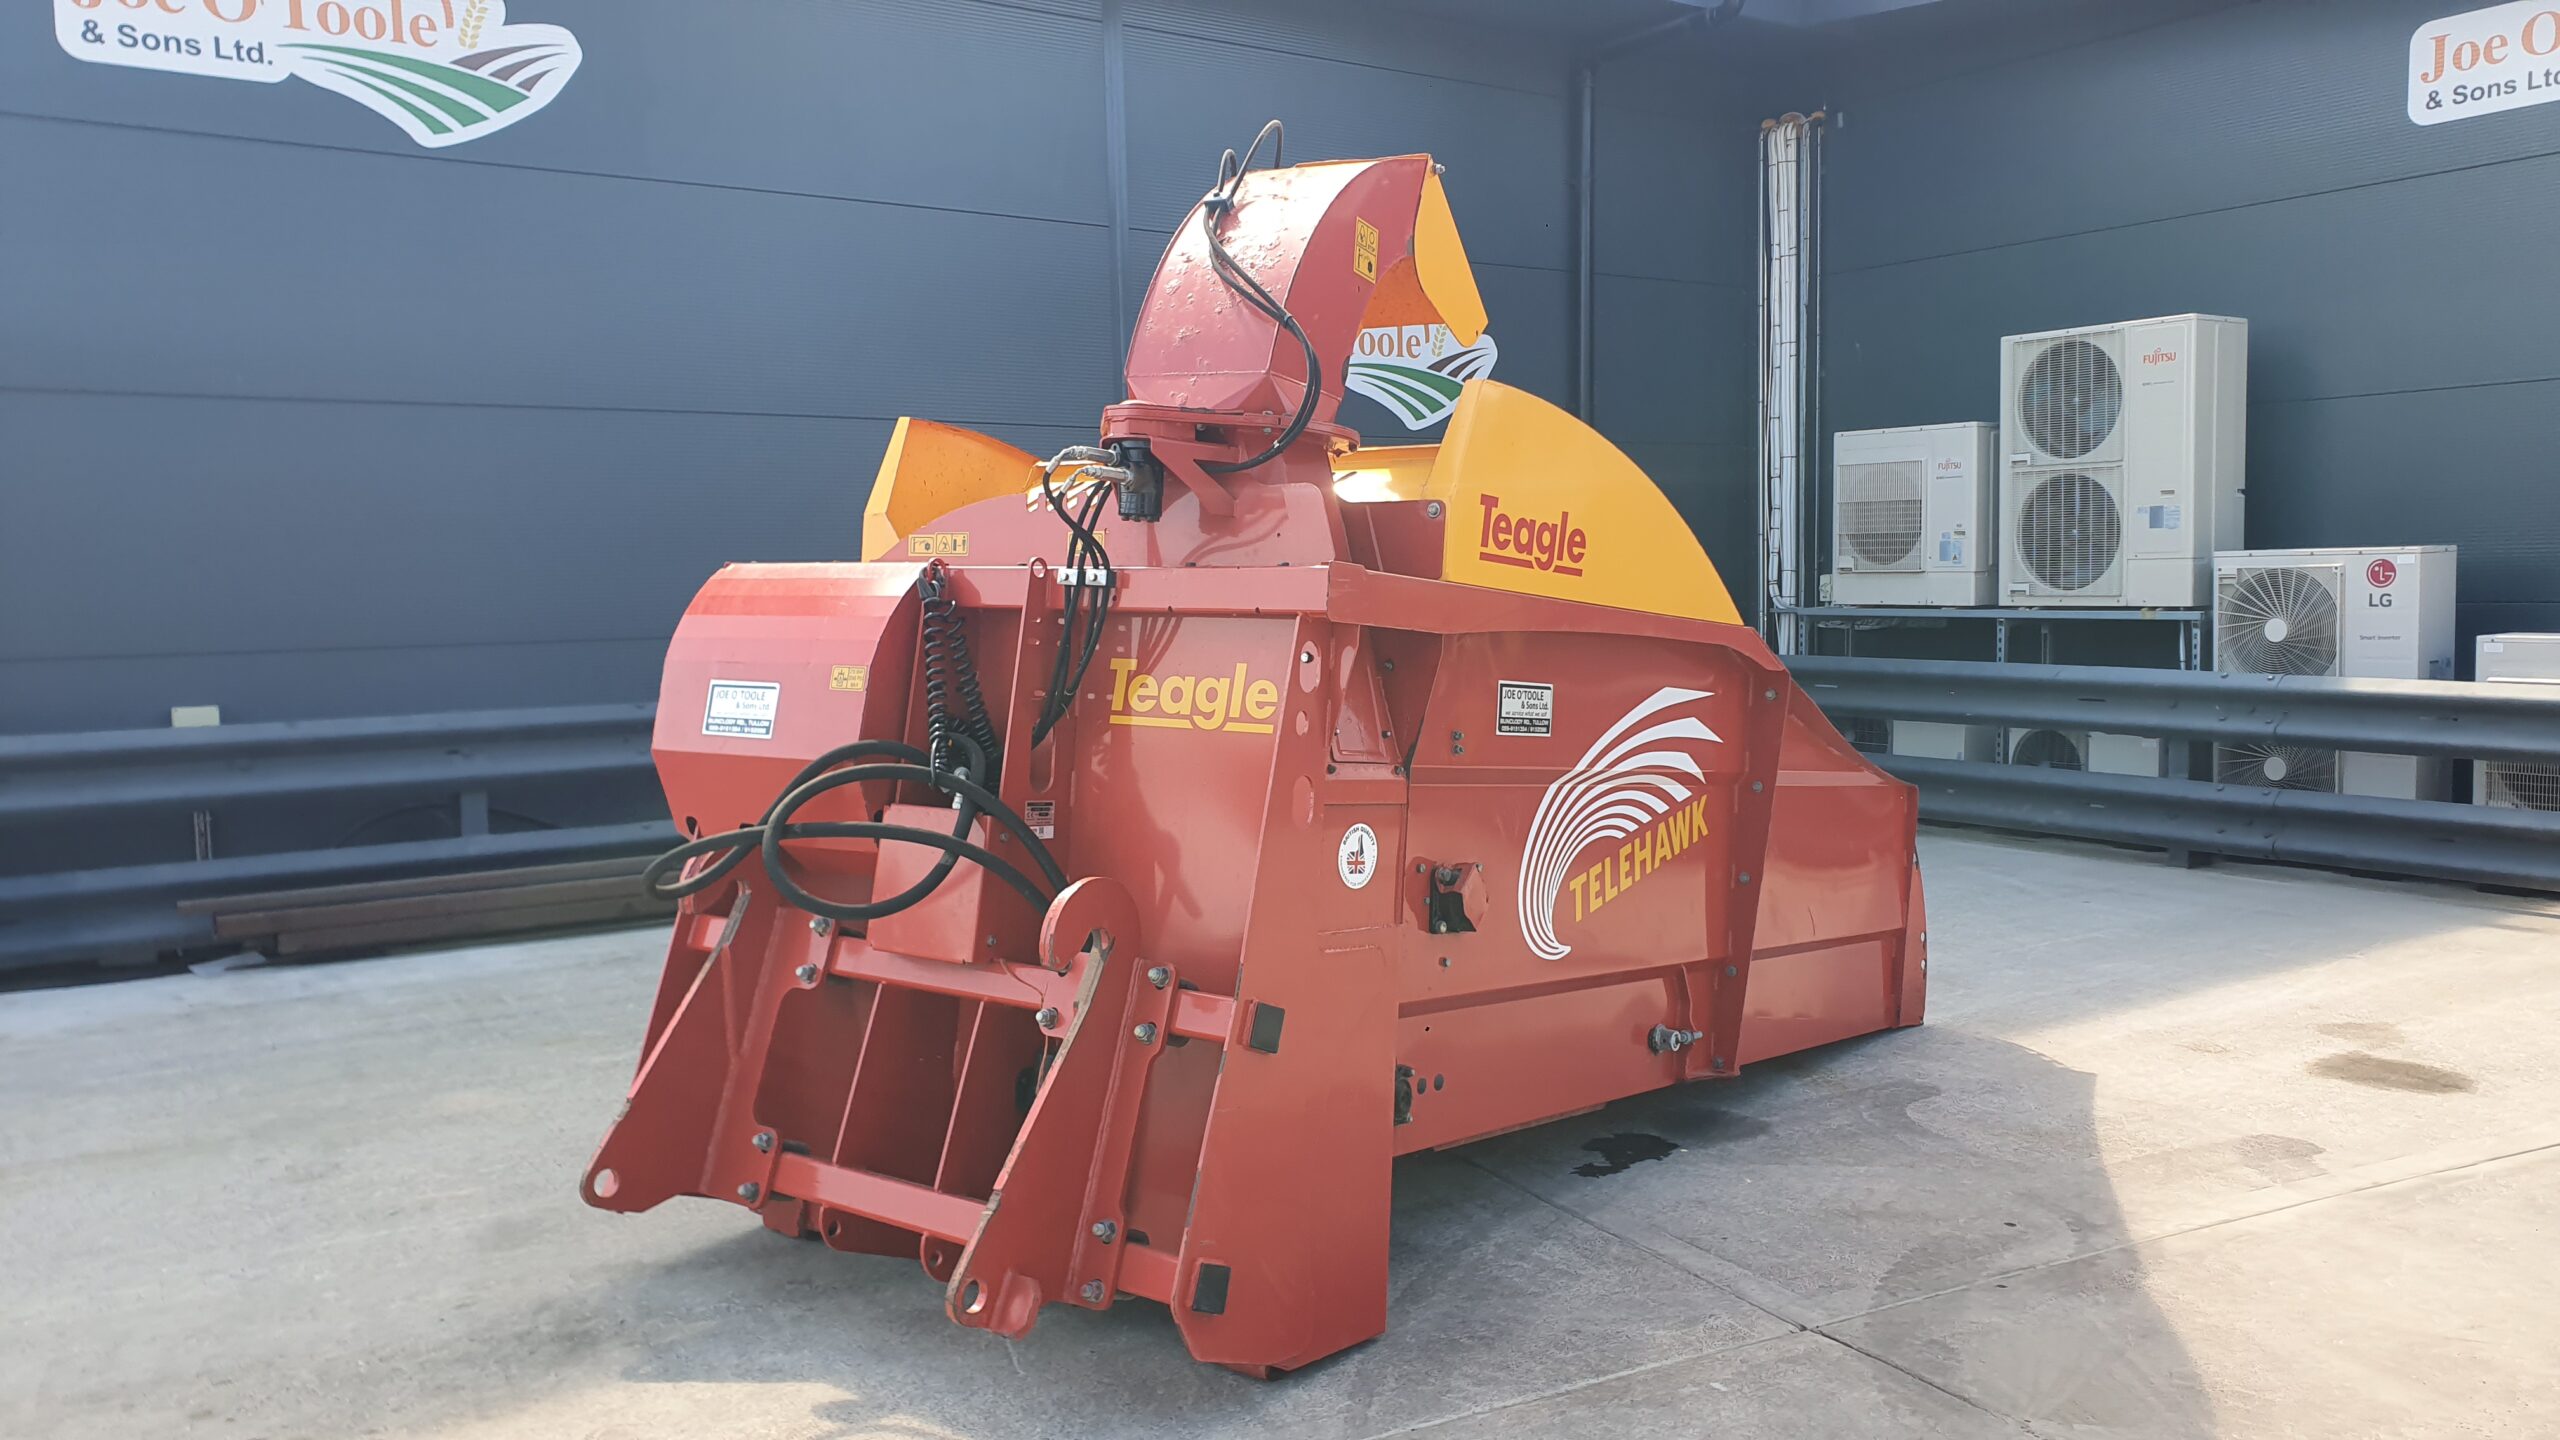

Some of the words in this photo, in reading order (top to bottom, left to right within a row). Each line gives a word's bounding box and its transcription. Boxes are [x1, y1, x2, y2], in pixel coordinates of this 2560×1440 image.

[81, 19, 105, 44] &
[117, 24, 201, 56] Sons
[214, 36, 273, 65] Ltd.
[2421, 34, 2509, 83] Joe
[2425, 90, 2442, 110] &
[2452, 79, 2517, 104] Sons
[1350, 325, 1421, 358] oole
[2143, 348, 2176, 365] FUJITSU
[1937, 459, 1961, 471] FUJITSU
[1480, 493, 1586, 571] Teagle
[2368, 593, 2392, 607] LG
[716, 690, 730, 699] JOE
[1110, 658, 1278, 730] Teagle
[1504, 690, 1516, 700] JOE
[1517, 690, 1544, 701] O'TOOLE
[1521, 701, 1525, 709] &
[1526, 701, 1538, 710] Sons
[1569, 794, 1709, 923] TELEHAWK
